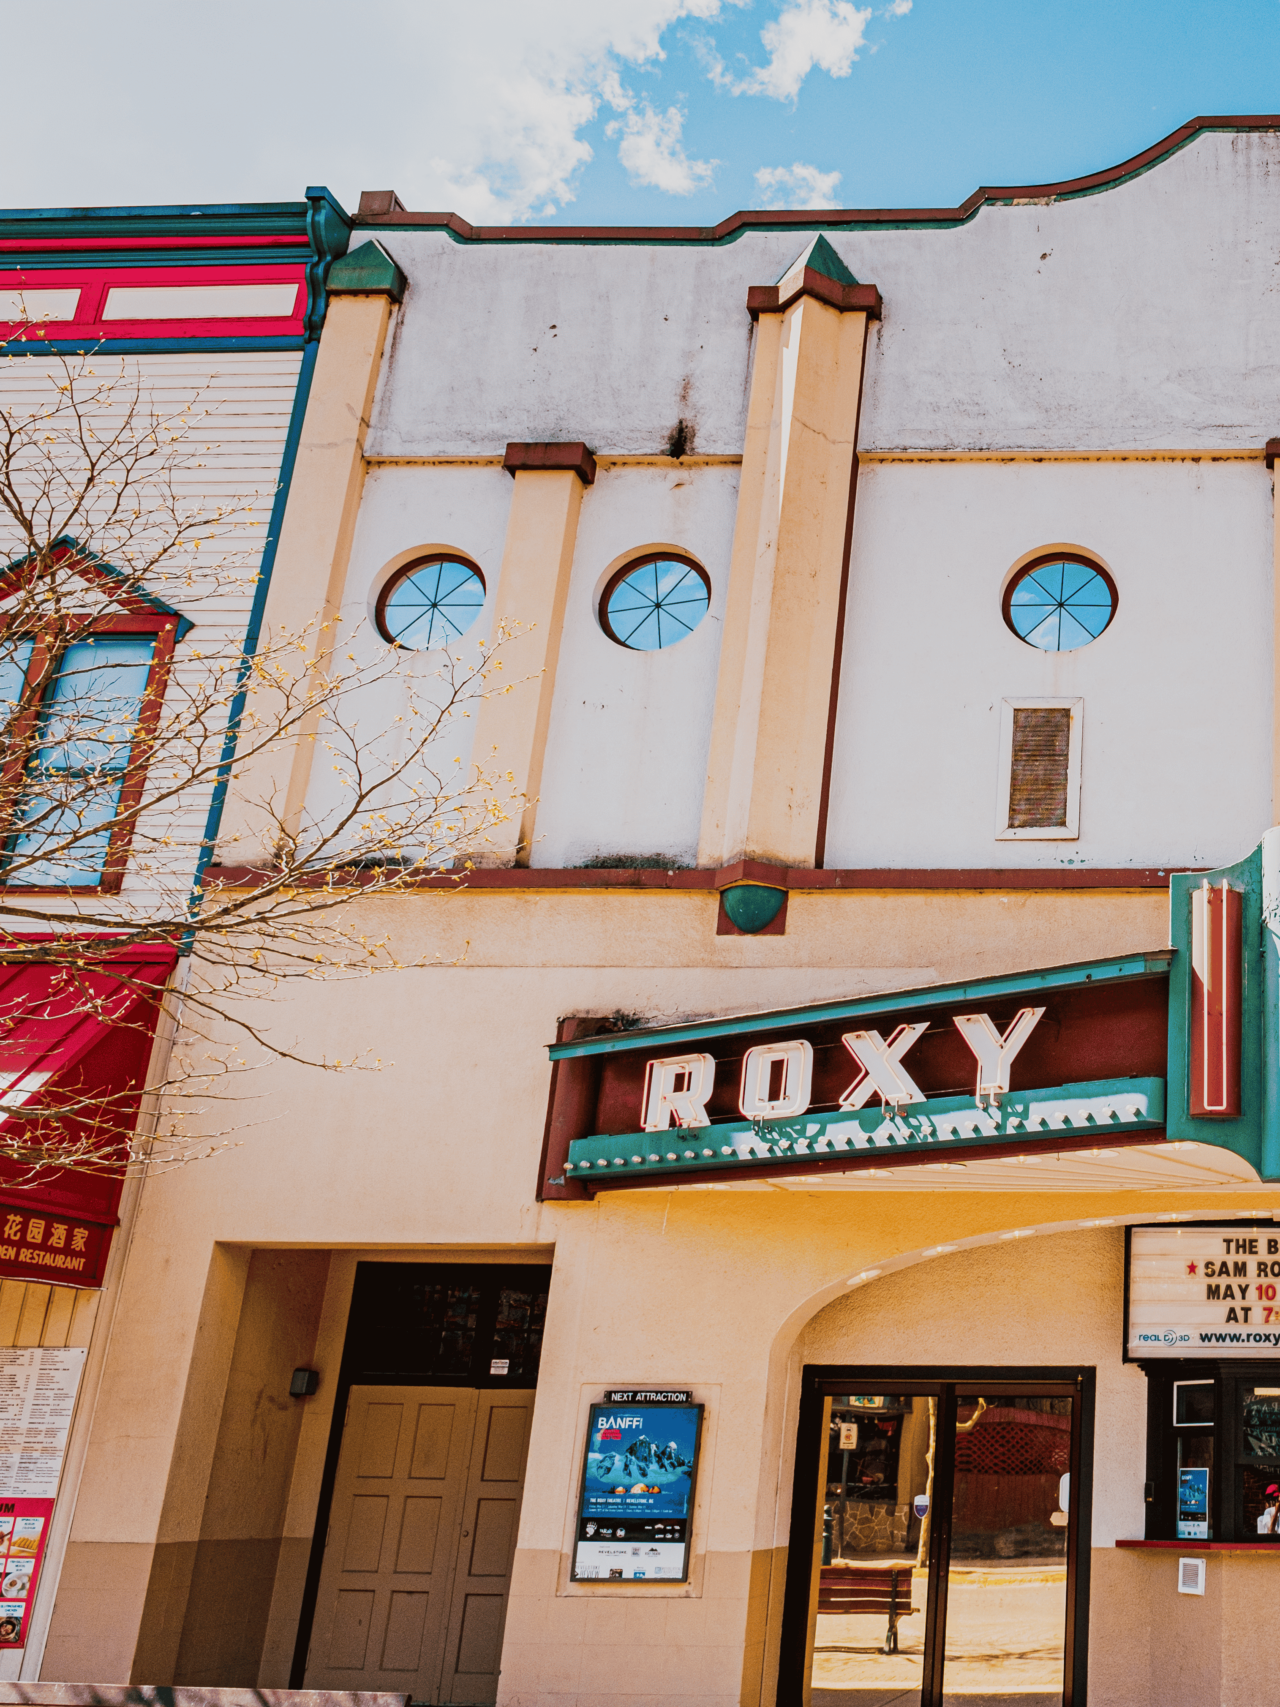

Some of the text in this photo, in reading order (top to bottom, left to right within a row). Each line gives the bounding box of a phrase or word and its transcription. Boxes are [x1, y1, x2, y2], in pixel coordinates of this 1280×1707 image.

[641, 1007, 1047, 1132] ROXY
[4, 1213, 89, 1252] 花园酒家
[1222, 1238, 1259, 1255] THE
[0, 1244, 86, 1271] EN RESTAURANT
[1204, 1260, 1248, 1278] SAM
[1206, 1283, 1250, 1301] MAY
[1255, 1283, 1277, 1301] 10
[1225, 1306, 1252, 1324] AT
[611, 1392, 687, 1402] NEXT ATTRACTION
[597, 1416, 641, 1429] BANFF
